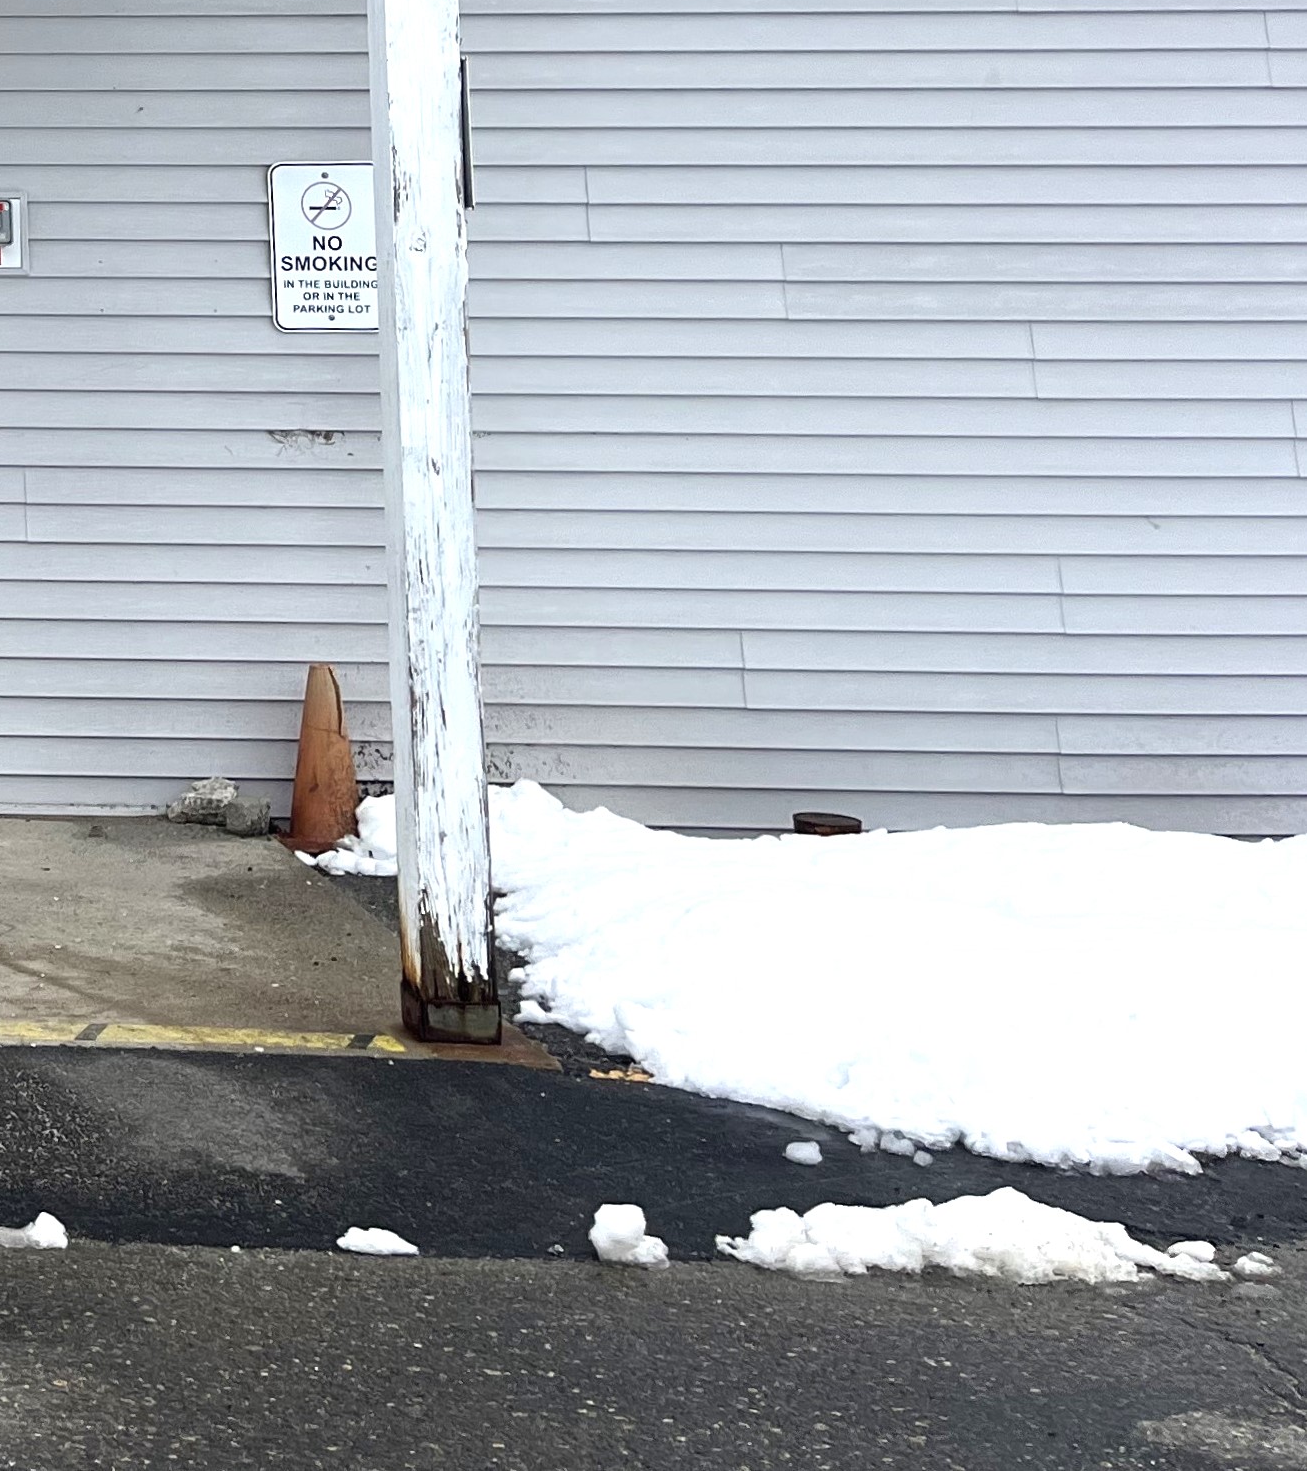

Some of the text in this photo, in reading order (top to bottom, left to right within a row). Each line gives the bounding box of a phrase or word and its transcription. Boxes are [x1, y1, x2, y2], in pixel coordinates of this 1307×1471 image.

[313, 236, 342, 250] NO
[281, 256, 377, 271] SMOKING
[284, 280, 378, 289] IN THE BUILDING
[303, 292, 360, 300] OR IN THE
[293, 305, 370, 313] PARKING LOT
